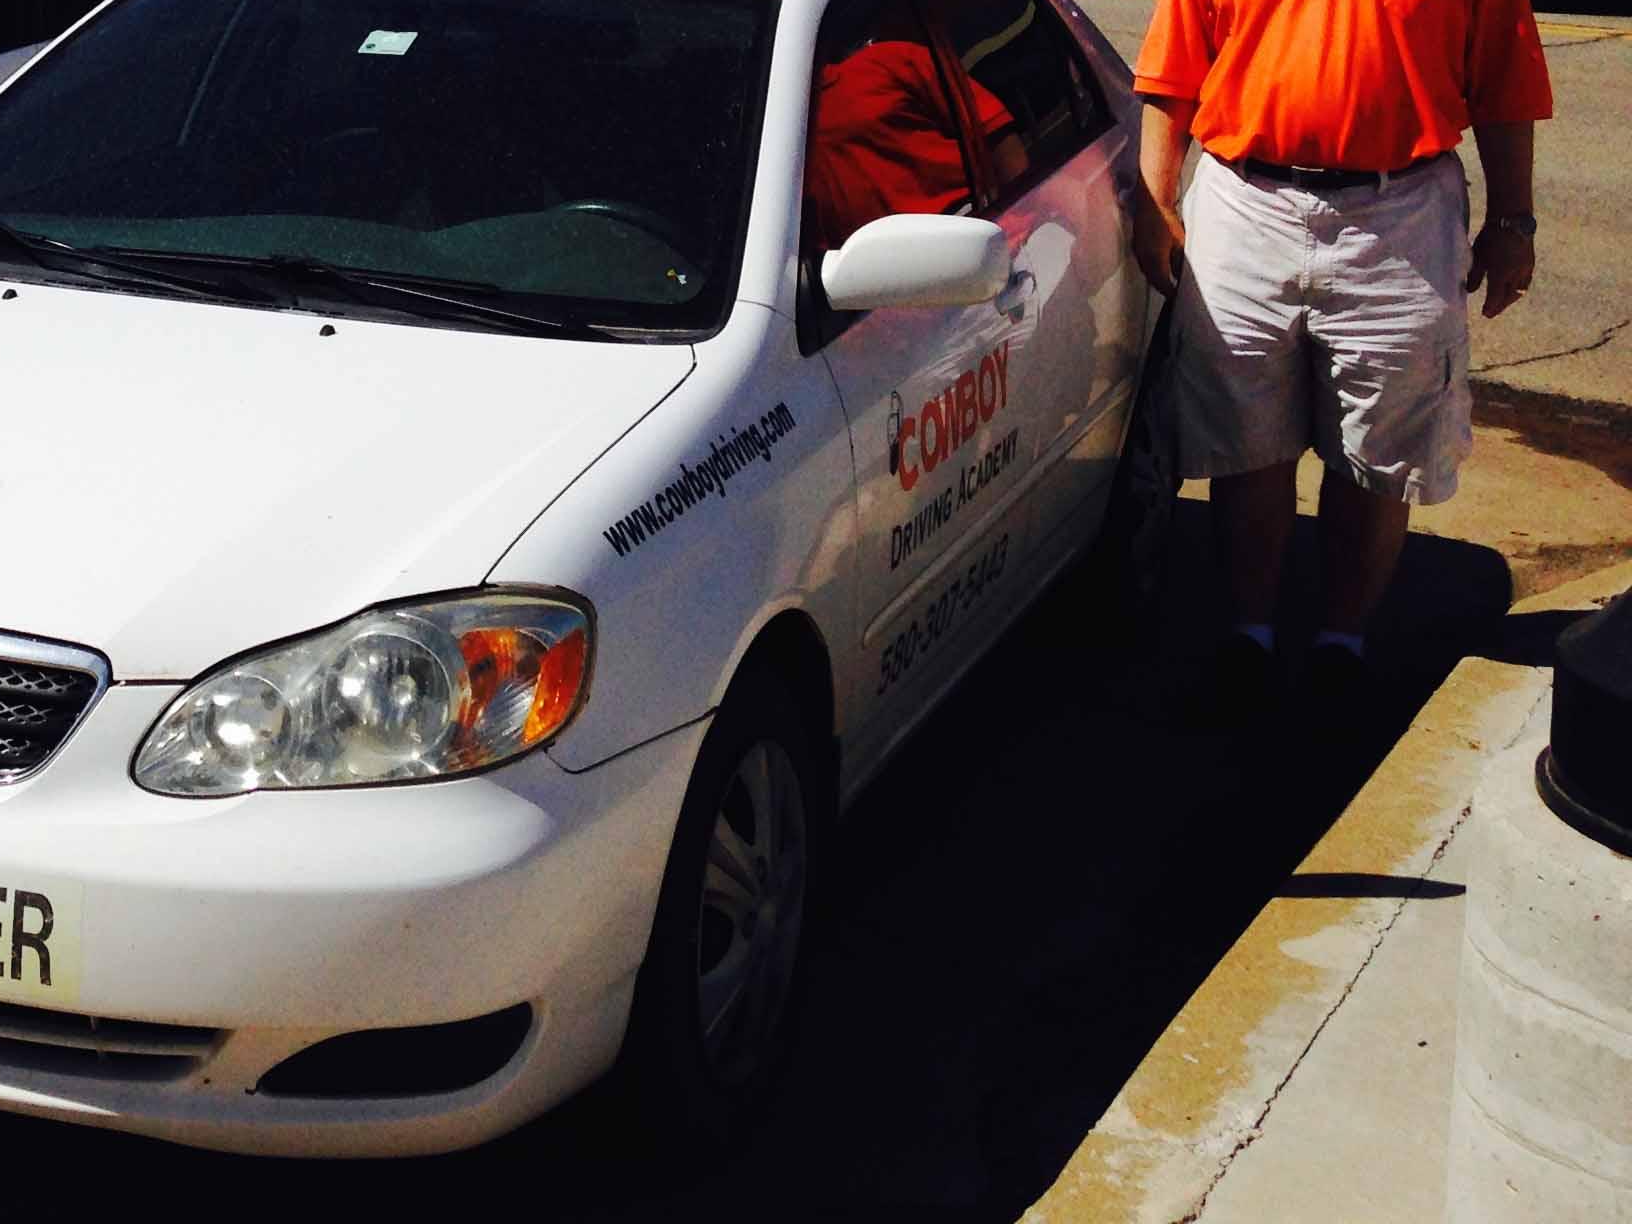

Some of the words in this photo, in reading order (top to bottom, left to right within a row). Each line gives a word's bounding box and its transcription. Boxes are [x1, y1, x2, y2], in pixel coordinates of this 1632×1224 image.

[602, 402, 797, 558] www.cowboydriving.com
[898, 339, 1009, 492] COWBOY
[889, 487, 953, 572] DRIVING
[956, 428, 1019, 512] ACADEMY
